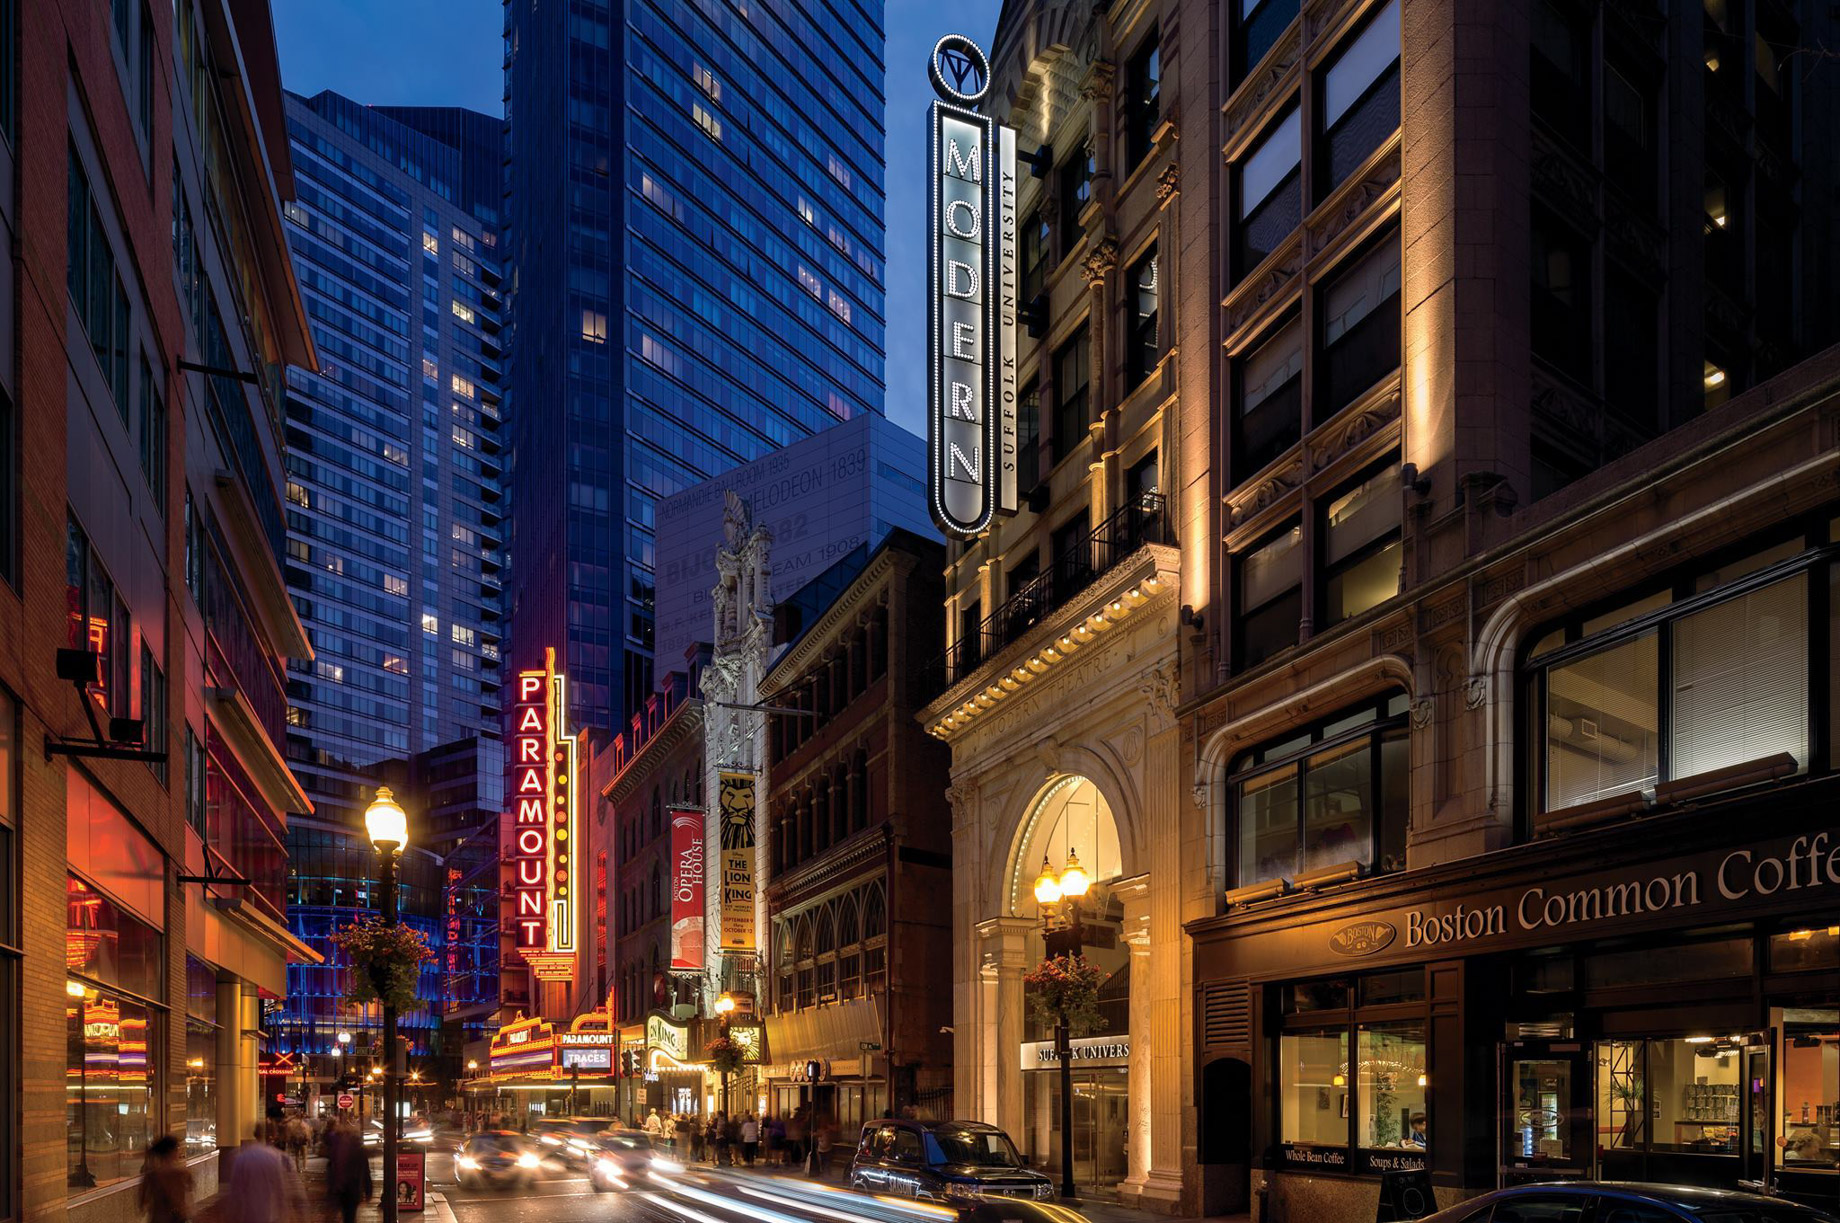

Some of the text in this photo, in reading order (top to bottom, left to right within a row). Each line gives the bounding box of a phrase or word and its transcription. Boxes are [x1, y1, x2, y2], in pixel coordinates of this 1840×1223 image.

[946, 138, 982, 484] MODERN
[1002, 170, 1015, 472] SUFFOLK UNIVERSITY
[831, 448, 866, 482] 1839
[661, 484, 712, 521] NORMANDIE
[714, 463, 765, 499] BALLROOM
[771, 536, 860, 577] EAM 1908
[1048, 650, 1112, 705] THEATRE
[518, 677, 545, 945] PARAMOUNT
[678, 849, 693, 902] OPERA
[692, 838, 703, 884] HOUSE
[728, 859, 747, 869] THE
[1404, 903, 1507, 948] Boston
[1517, 869, 1702, 931] Common
[1347, 925, 1375, 946] BOSTON
[562, 1034, 614, 1044] PARAMOUNT
[568, 1054, 606, 1063] TRACES
[1083, 1043, 1129, 1059] UNIVERS
[1285, 1149, 1345, 1165] Whole Bean Coffee
[1370, 1155, 1425, 1171] Soups & Salads
